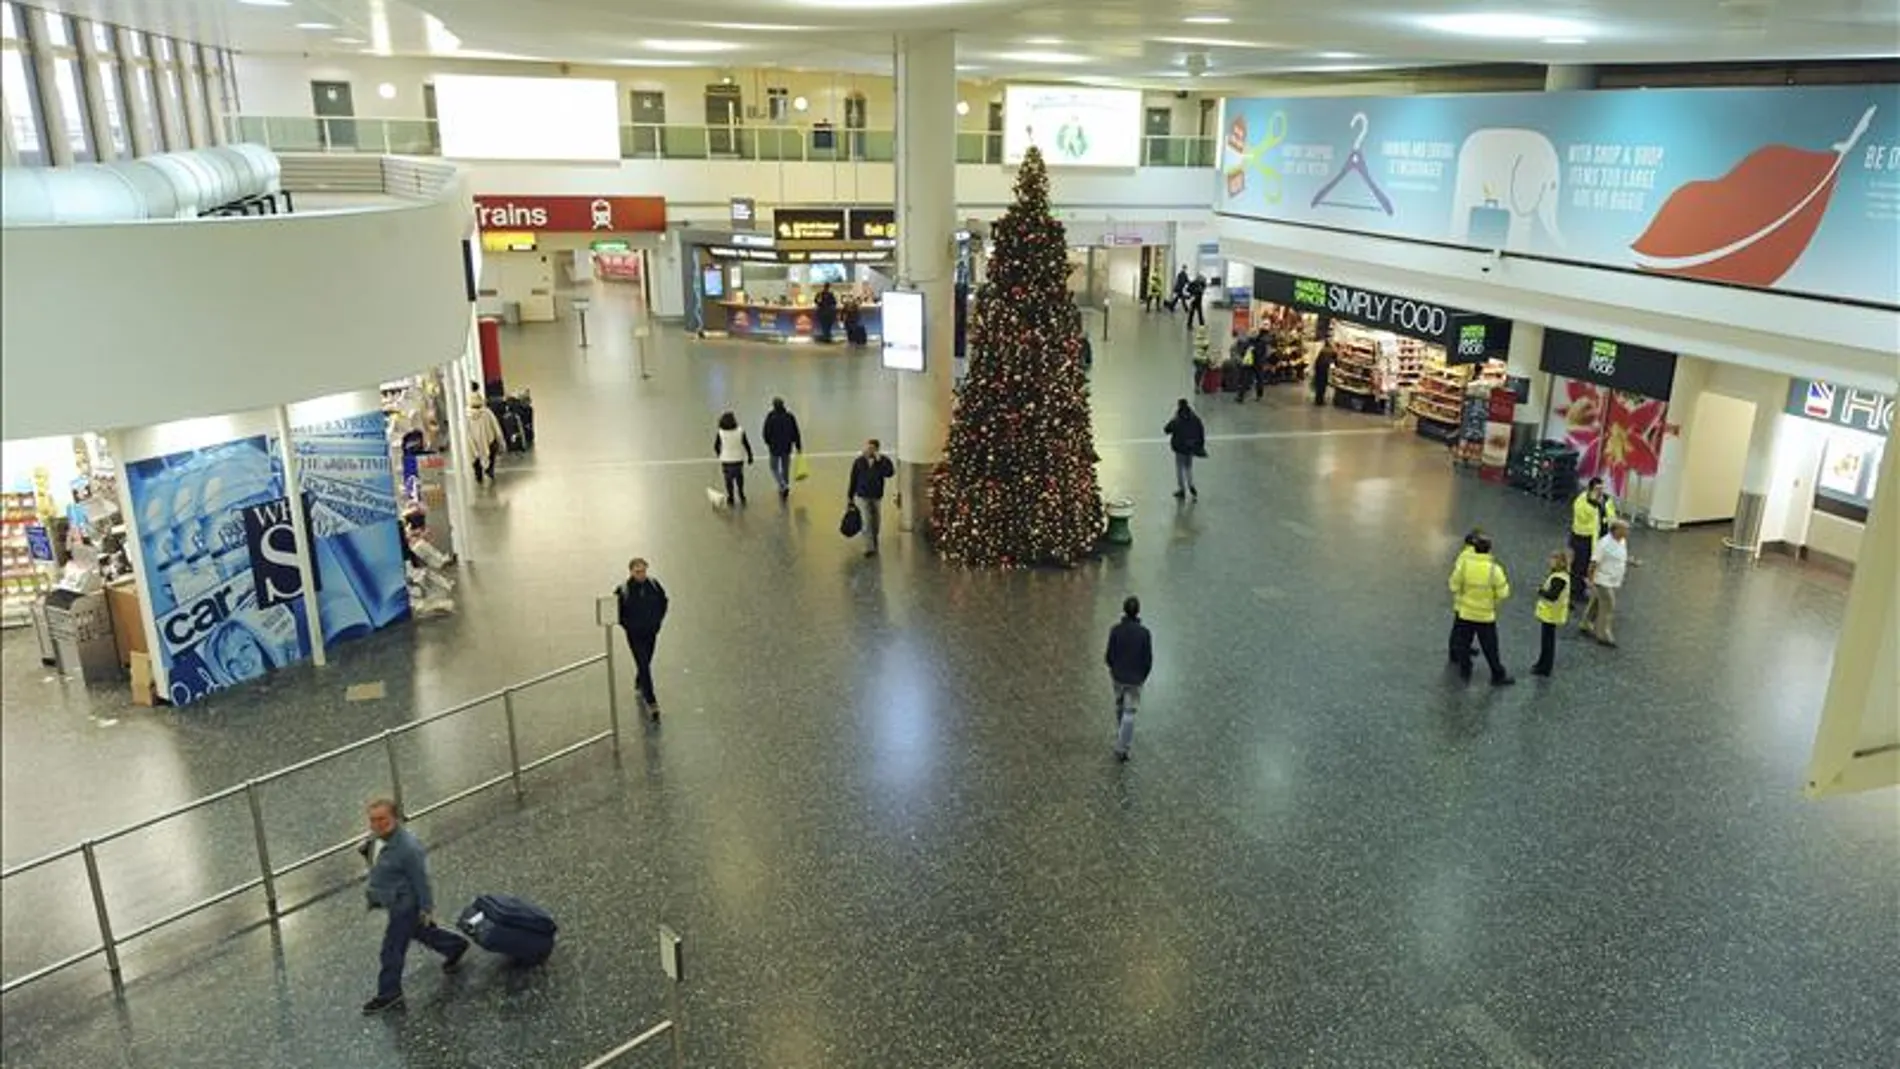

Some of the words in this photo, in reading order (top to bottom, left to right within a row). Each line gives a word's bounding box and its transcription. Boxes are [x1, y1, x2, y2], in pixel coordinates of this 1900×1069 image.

[1328, 284, 1388, 322] SIMPLY
[1389, 298, 1448, 336] FOOD
[164, 585, 232, 644] car
